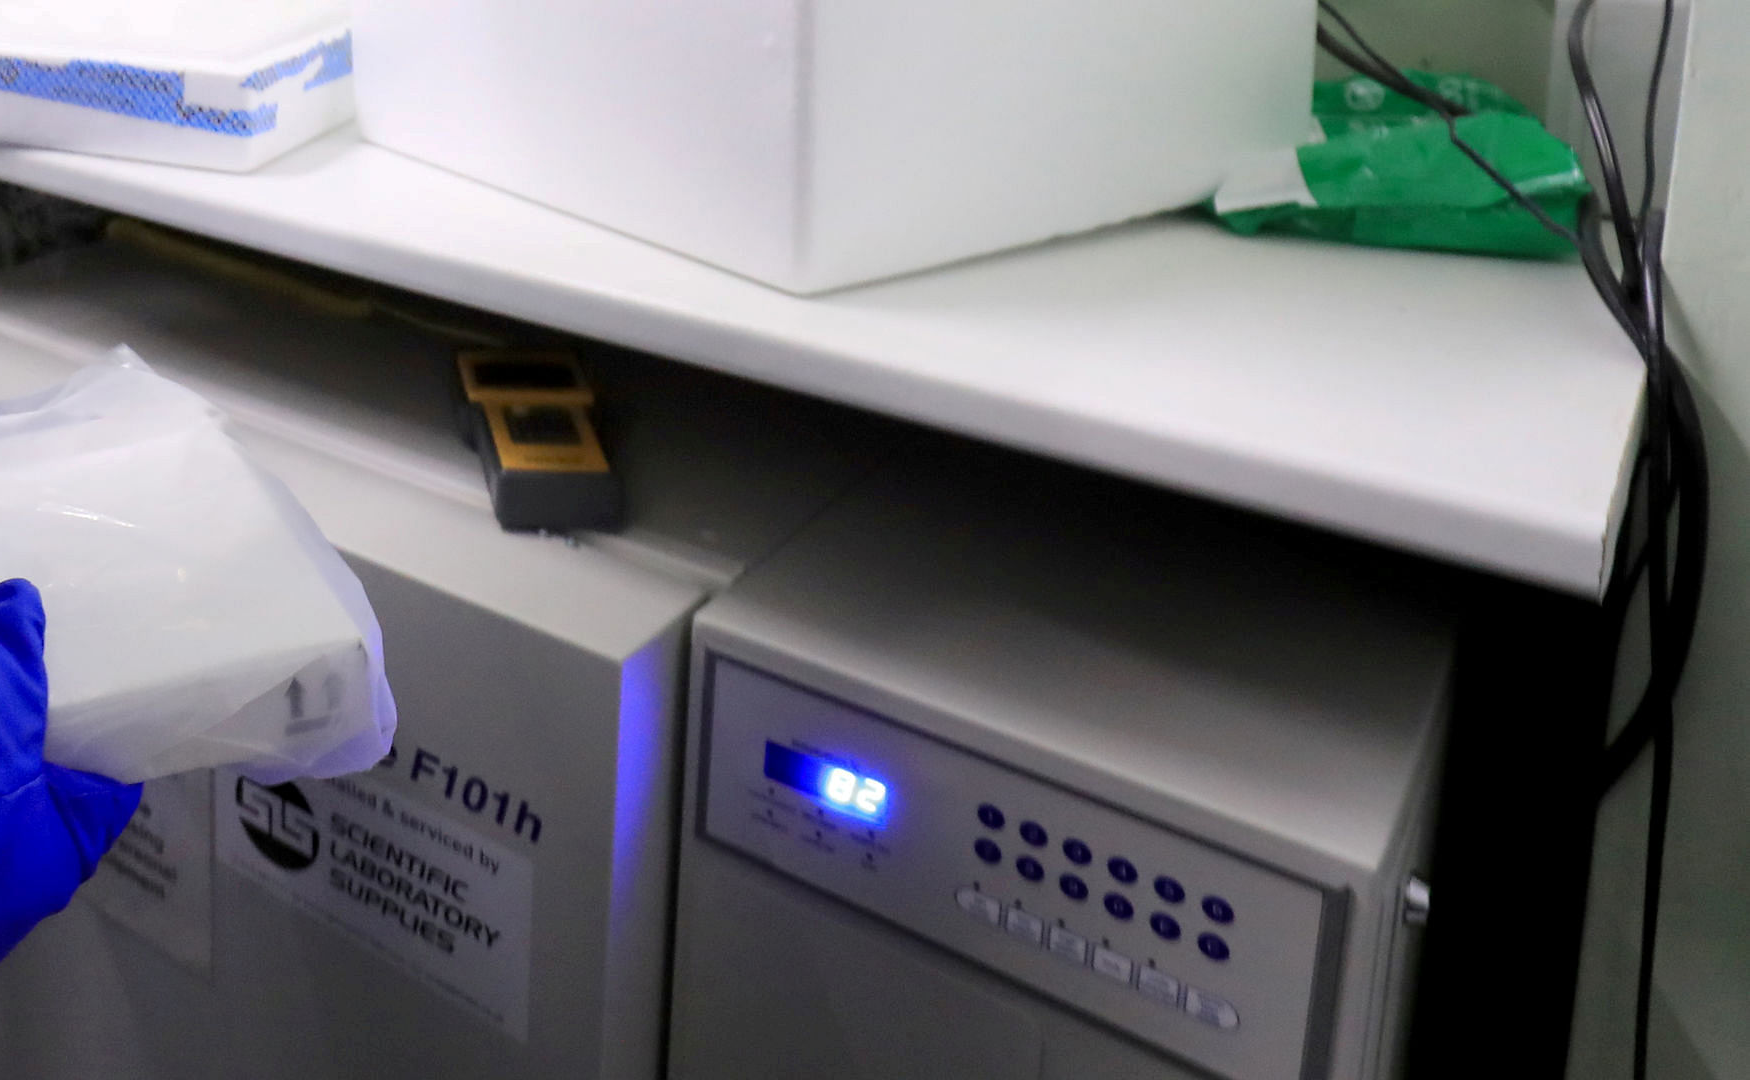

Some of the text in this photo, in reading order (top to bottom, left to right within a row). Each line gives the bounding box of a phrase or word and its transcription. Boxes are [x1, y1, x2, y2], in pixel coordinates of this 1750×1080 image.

[408, 747, 544, 844] F101h
[826, 766, 888, 814] 82
[331, 813, 470, 903] SCIENTIFIC
[400, 808, 475, 861] serviced
[479, 849, 501, 877] by
[329, 868, 456, 954] SUPPLIES
[330, 840, 502, 949] LABORATORY
